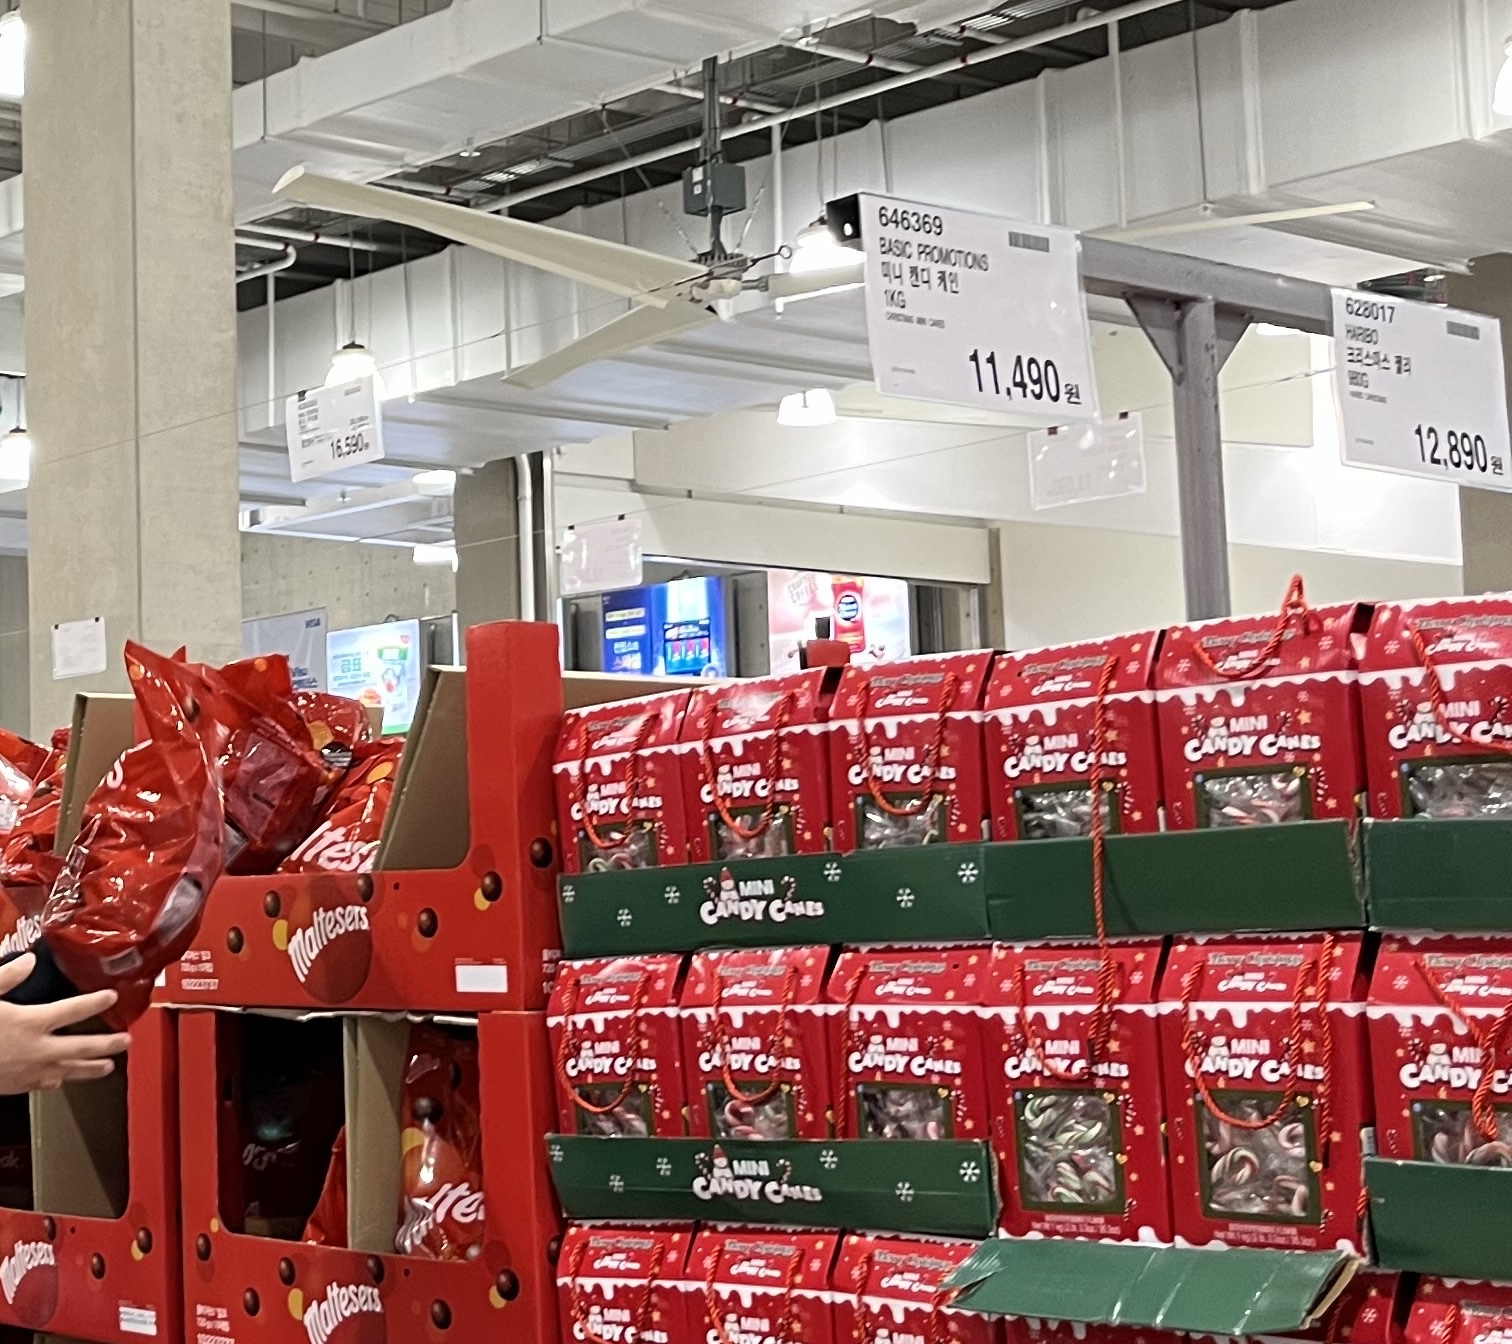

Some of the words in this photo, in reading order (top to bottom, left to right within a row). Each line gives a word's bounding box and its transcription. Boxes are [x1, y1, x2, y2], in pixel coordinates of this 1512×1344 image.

[878, 205, 944, 236] 646369
[879, 236, 912, 259] BASIC
[917, 243, 989, 272] PROMOTIONS
[881, 260, 904, 286] 미니
[884, 289, 906, 309] 1KG
[1183, 734, 1258, 762] CANDY
[1003, 753, 1070, 778] CANDY
[699, 898, 766, 925] CANDY
[287, 904, 370, 983] Maltesers
[565, 1056, 614, 1077] CANDY
[848, 1052, 909, 1073] CANDY
[1399, 1062, 1482, 1089] CANDY
[692, 1176, 763, 1201] CANDY
